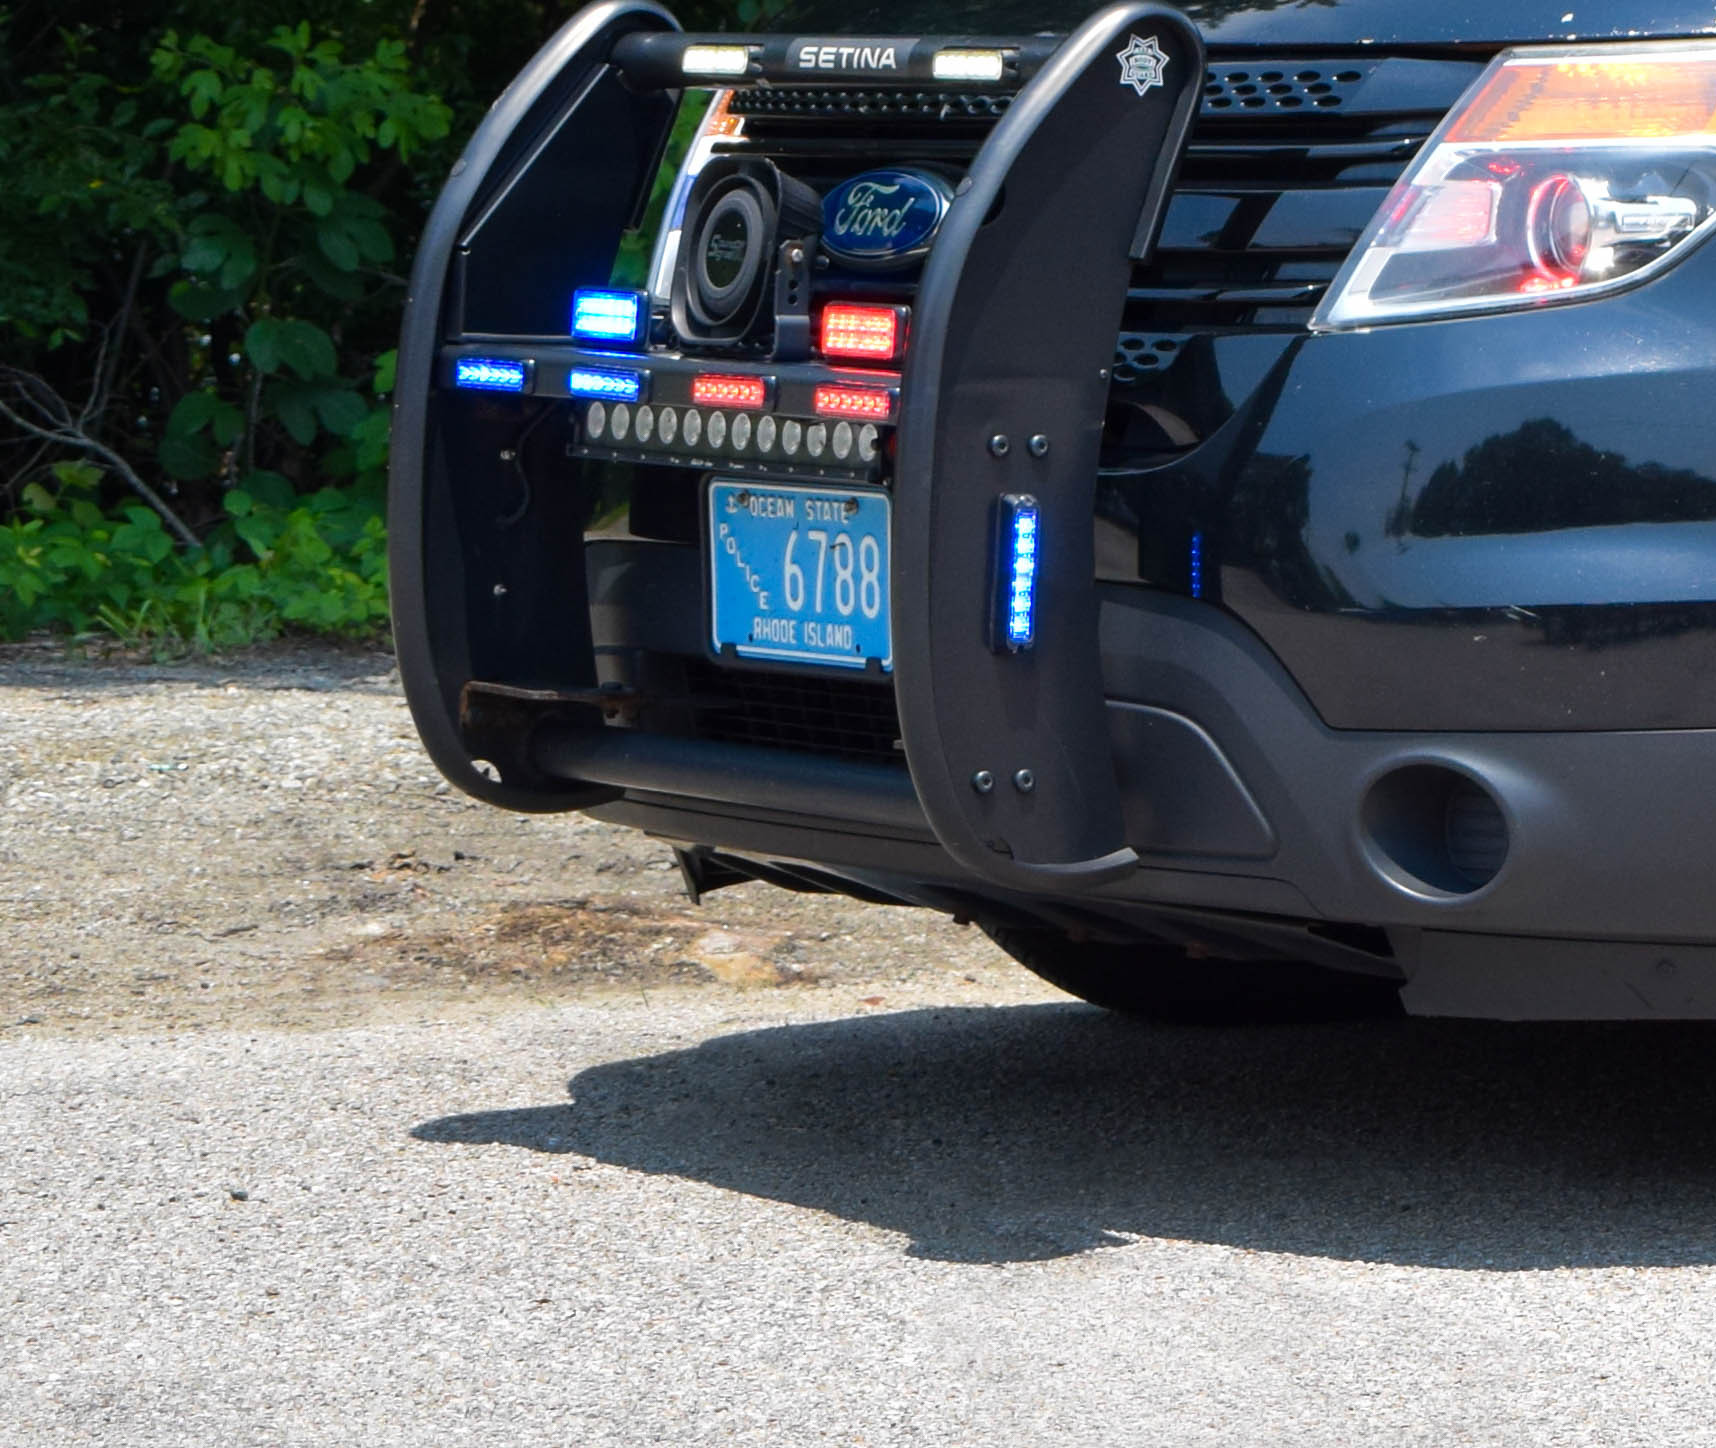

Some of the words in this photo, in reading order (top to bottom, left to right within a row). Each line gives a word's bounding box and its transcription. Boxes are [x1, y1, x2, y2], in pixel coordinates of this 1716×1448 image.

[799, 46, 897, 70] SETINA
[833, 181, 915, 238] Ford
[749, 496, 795, 519] OCEAN
[805, 500, 849, 524] STATE
[719, 523, 769, 610] POLICE
[784, 529, 881, 620] 6788
[753, 617, 798, 644] RHODE
[804, 622, 853, 649] ISLAND
